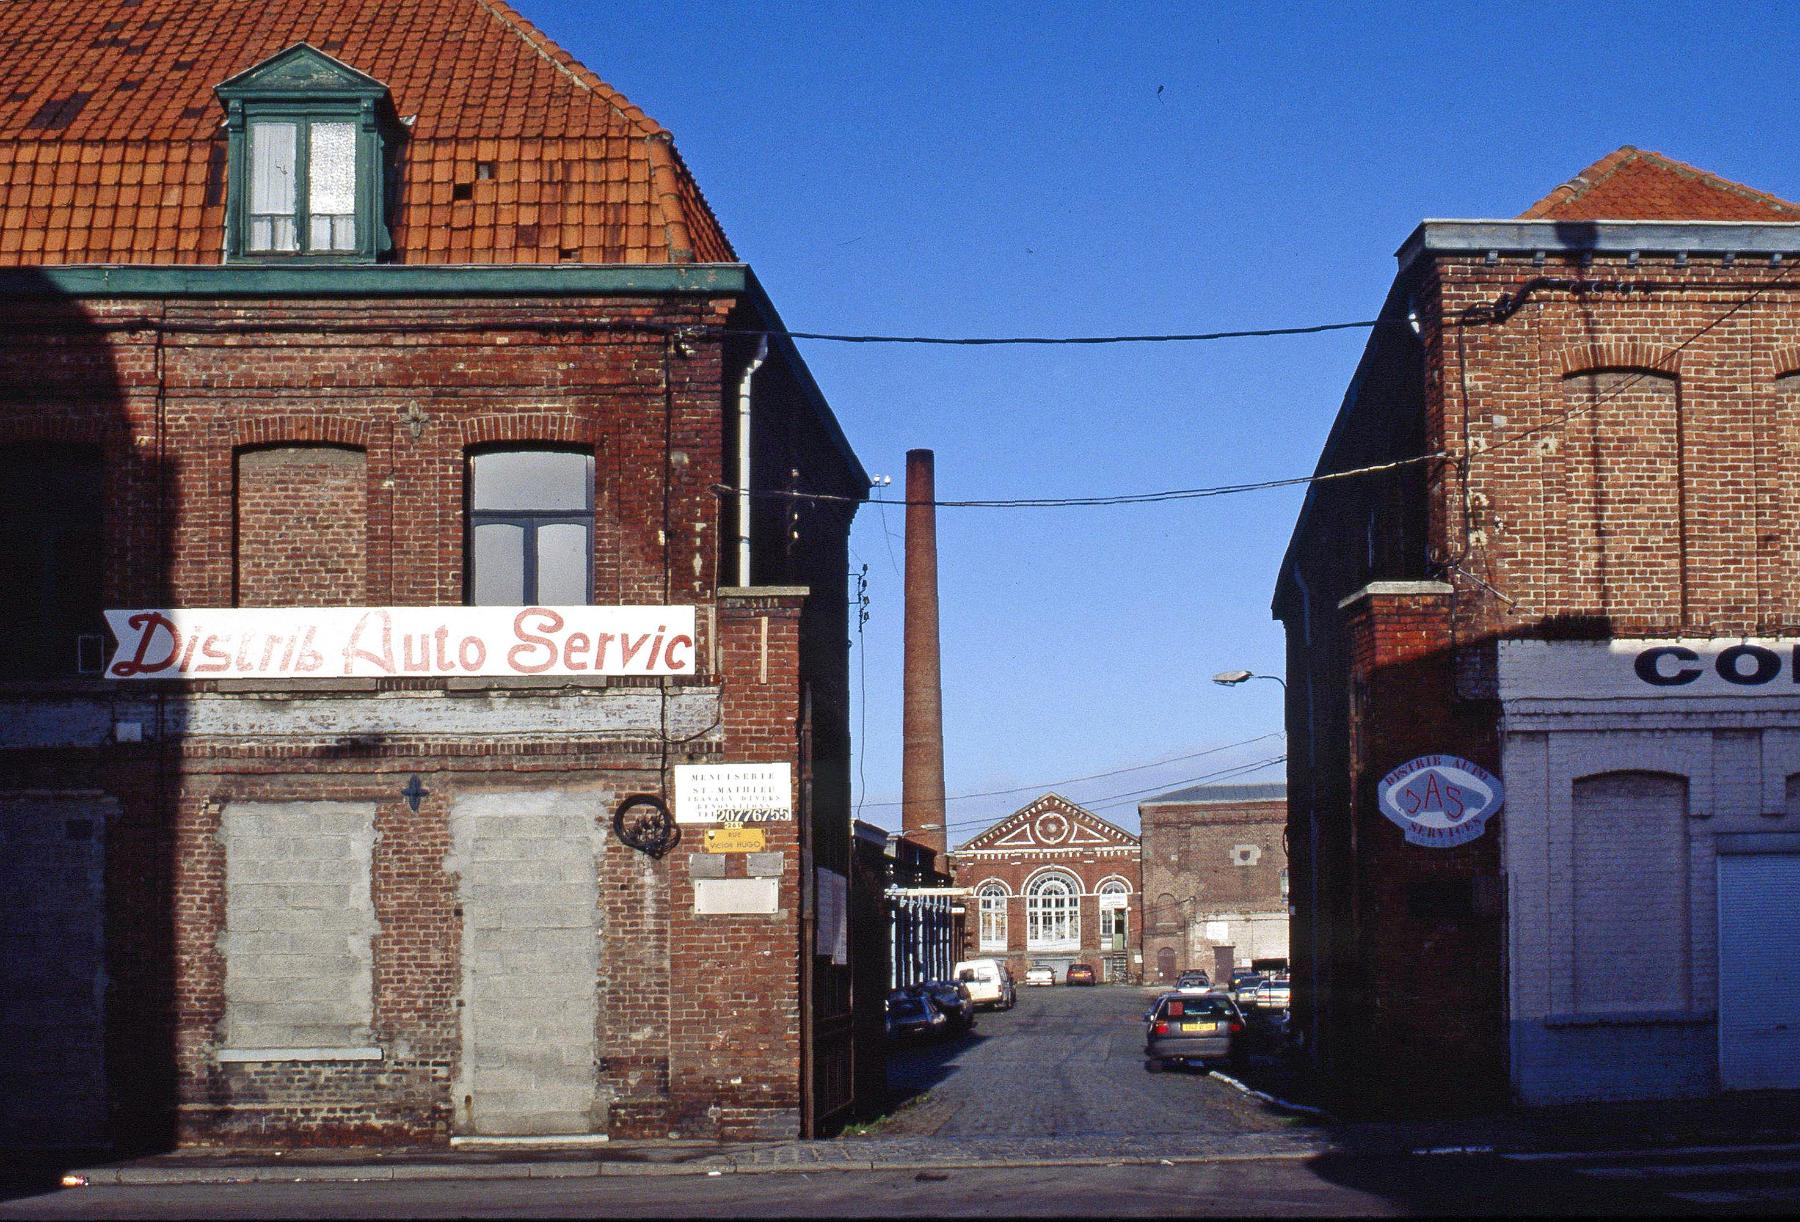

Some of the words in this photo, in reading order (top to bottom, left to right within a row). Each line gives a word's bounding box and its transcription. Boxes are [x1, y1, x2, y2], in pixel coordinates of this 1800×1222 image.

[111, 610, 323, 676] Distrib
[341, 609, 488, 675] Auto
[507, 607, 694, 675] Servic
[1634, 644, 1800, 686] CO
[717, 809, 789, 822] 20776755
